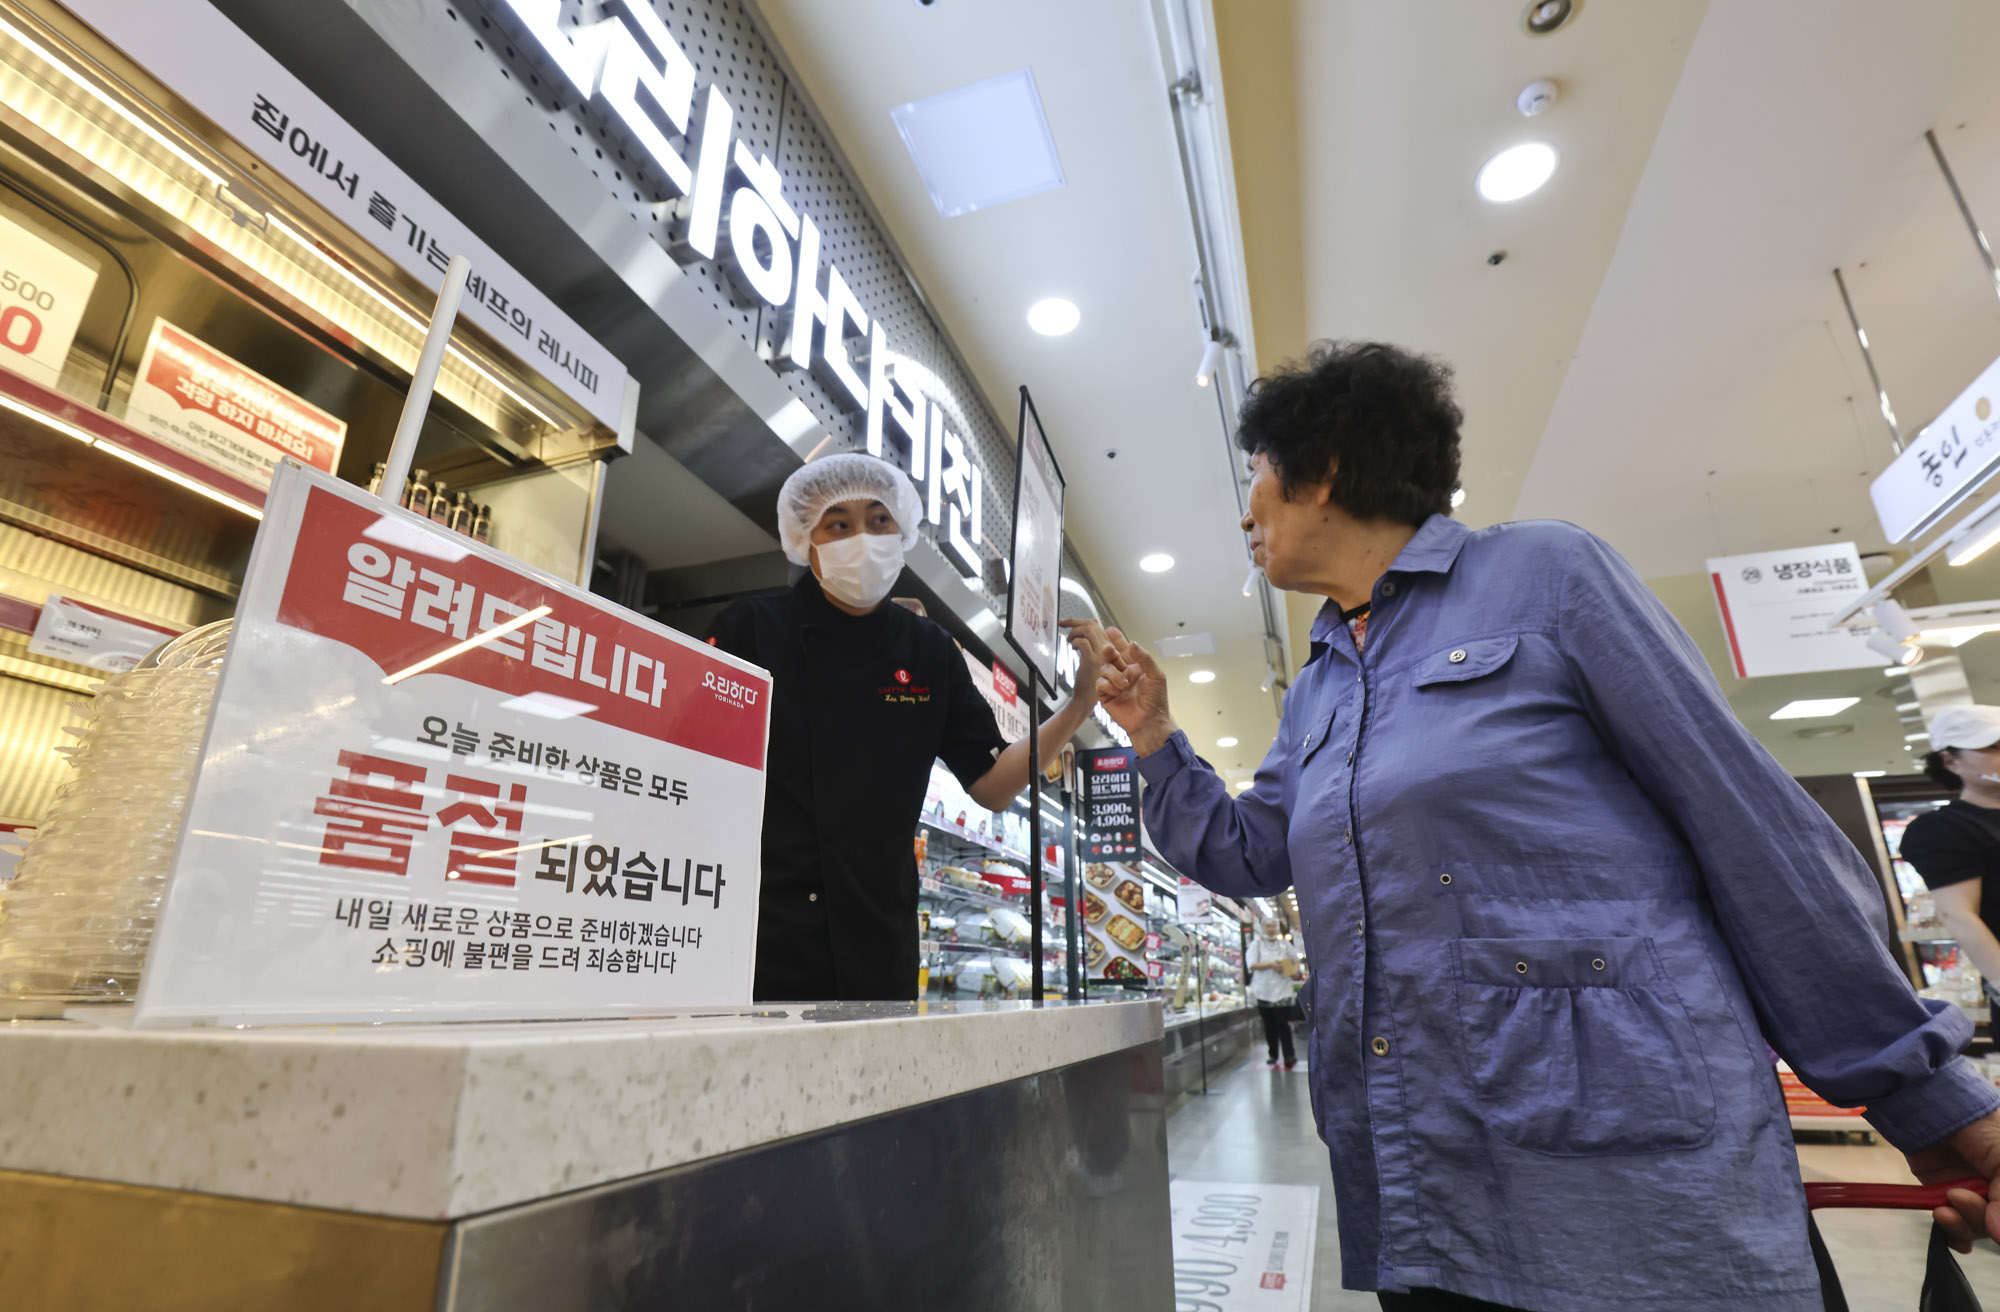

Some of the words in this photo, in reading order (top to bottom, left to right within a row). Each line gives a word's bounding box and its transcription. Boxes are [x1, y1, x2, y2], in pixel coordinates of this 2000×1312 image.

[251, 93, 360, 200] 집에서
[367, 190, 451, 275] 즐기는
[537, 329, 599, 395] 레시피
[216, 400, 256, 432] 하지
[255, 418, 315, 463] 마세요!
[1773, 557, 1853, 580] 냉장식품
[342, 541, 669, 709] 알려드립니다
[701, 671, 759, 705] 요리하다
[714, 693, 745, 709] YORIHADA
[416, 715, 481, 756] 오늘
[488, 731, 570, 779] 준비한
[575, 754, 643, 796] 상품은
[648, 773, 689, 806] 모두
[313, 749, 528, 888] 품절
[535, 838, 727, 910] 되었습니다
[335, 899, 393, 931] 내일
[402, 903, 480, 936] 새로운
[486, 910, 574, 942] 상품으로
[580, 917, 703, 949] 준비하겠습니다
[372, 939, 456, 969] 쇼핑에
[463, 942, 534, 972] 불편을
[538, 946, 582, 973] 드려
[586, 948, 677, 975] 죄송합니다
